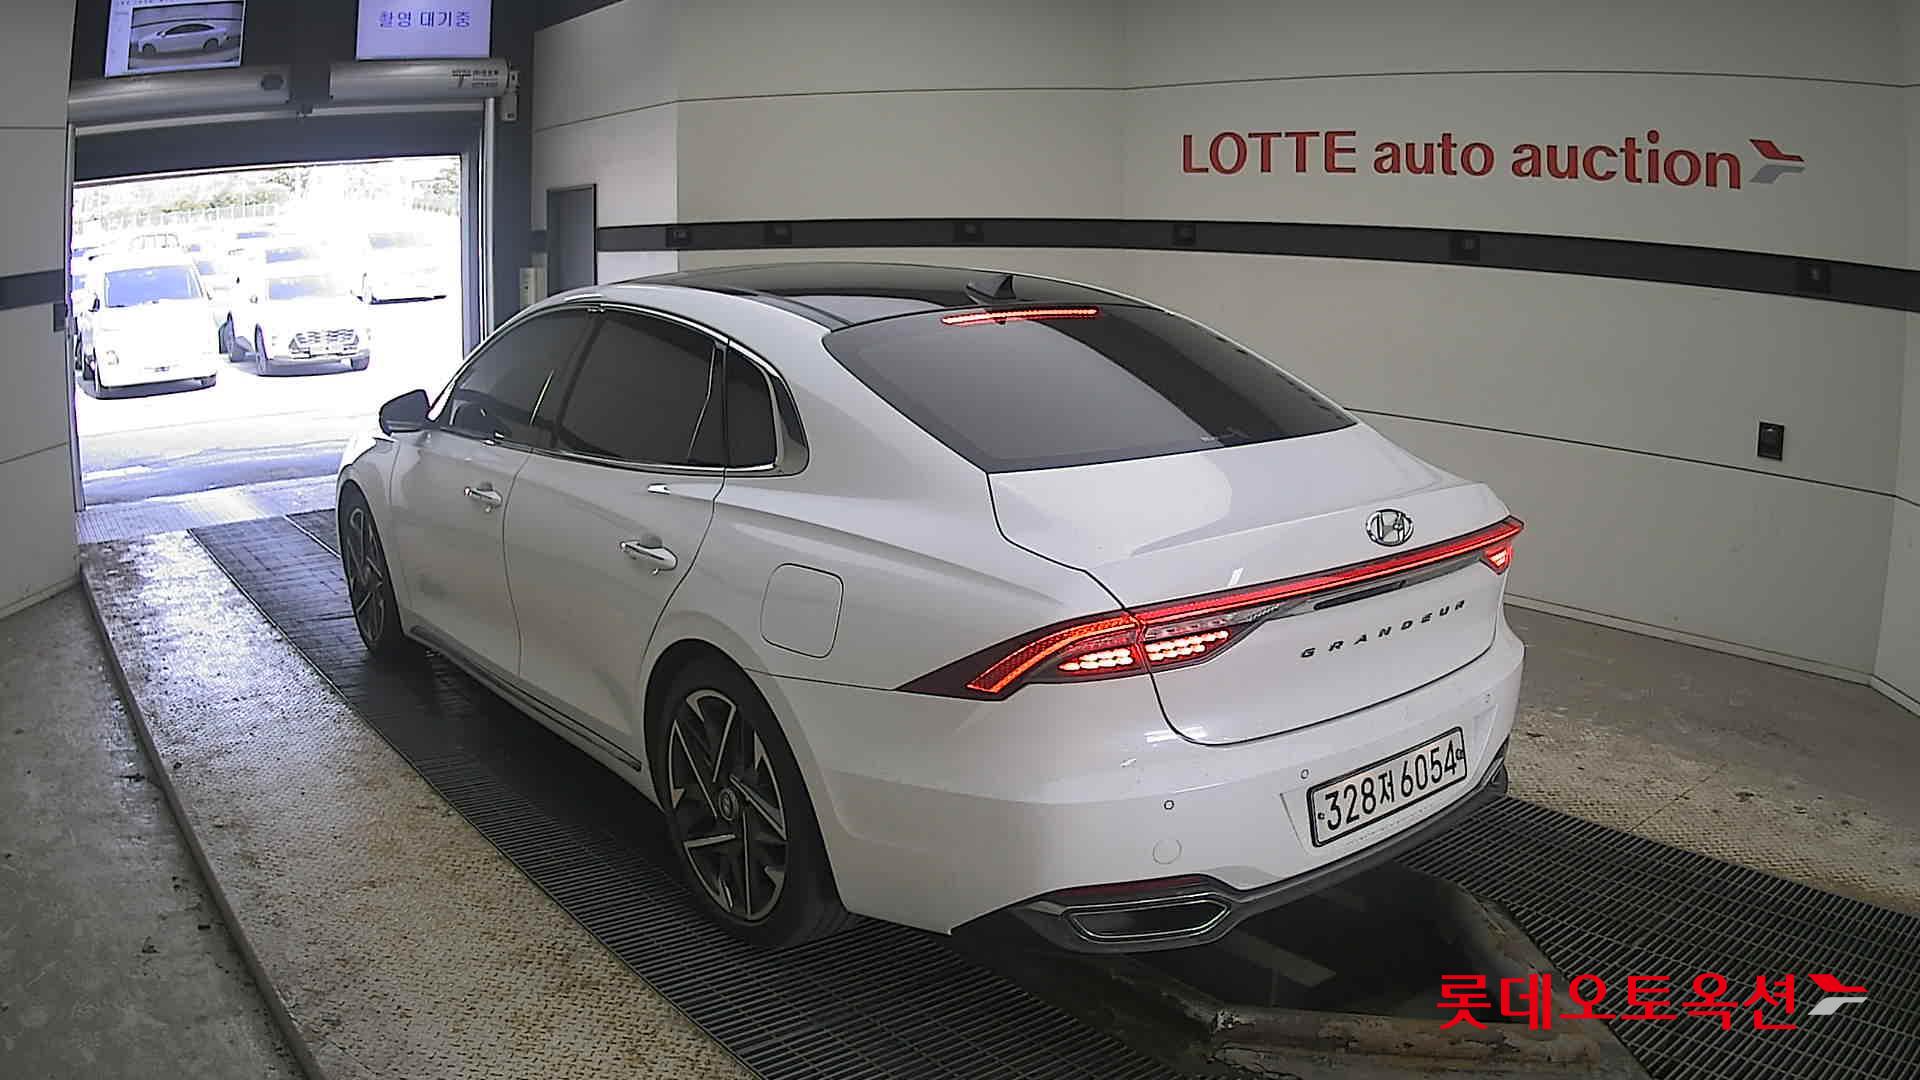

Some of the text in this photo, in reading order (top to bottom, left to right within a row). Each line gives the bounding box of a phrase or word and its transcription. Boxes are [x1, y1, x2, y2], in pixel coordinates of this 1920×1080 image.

[420, 10, 471, 28] 대기중
[1182, 129, 1742, 190] LOTTE auto auction
[1300, 599, 1466, 659] GRANDEUR
[1400, 739, 1458, 798] 6054
